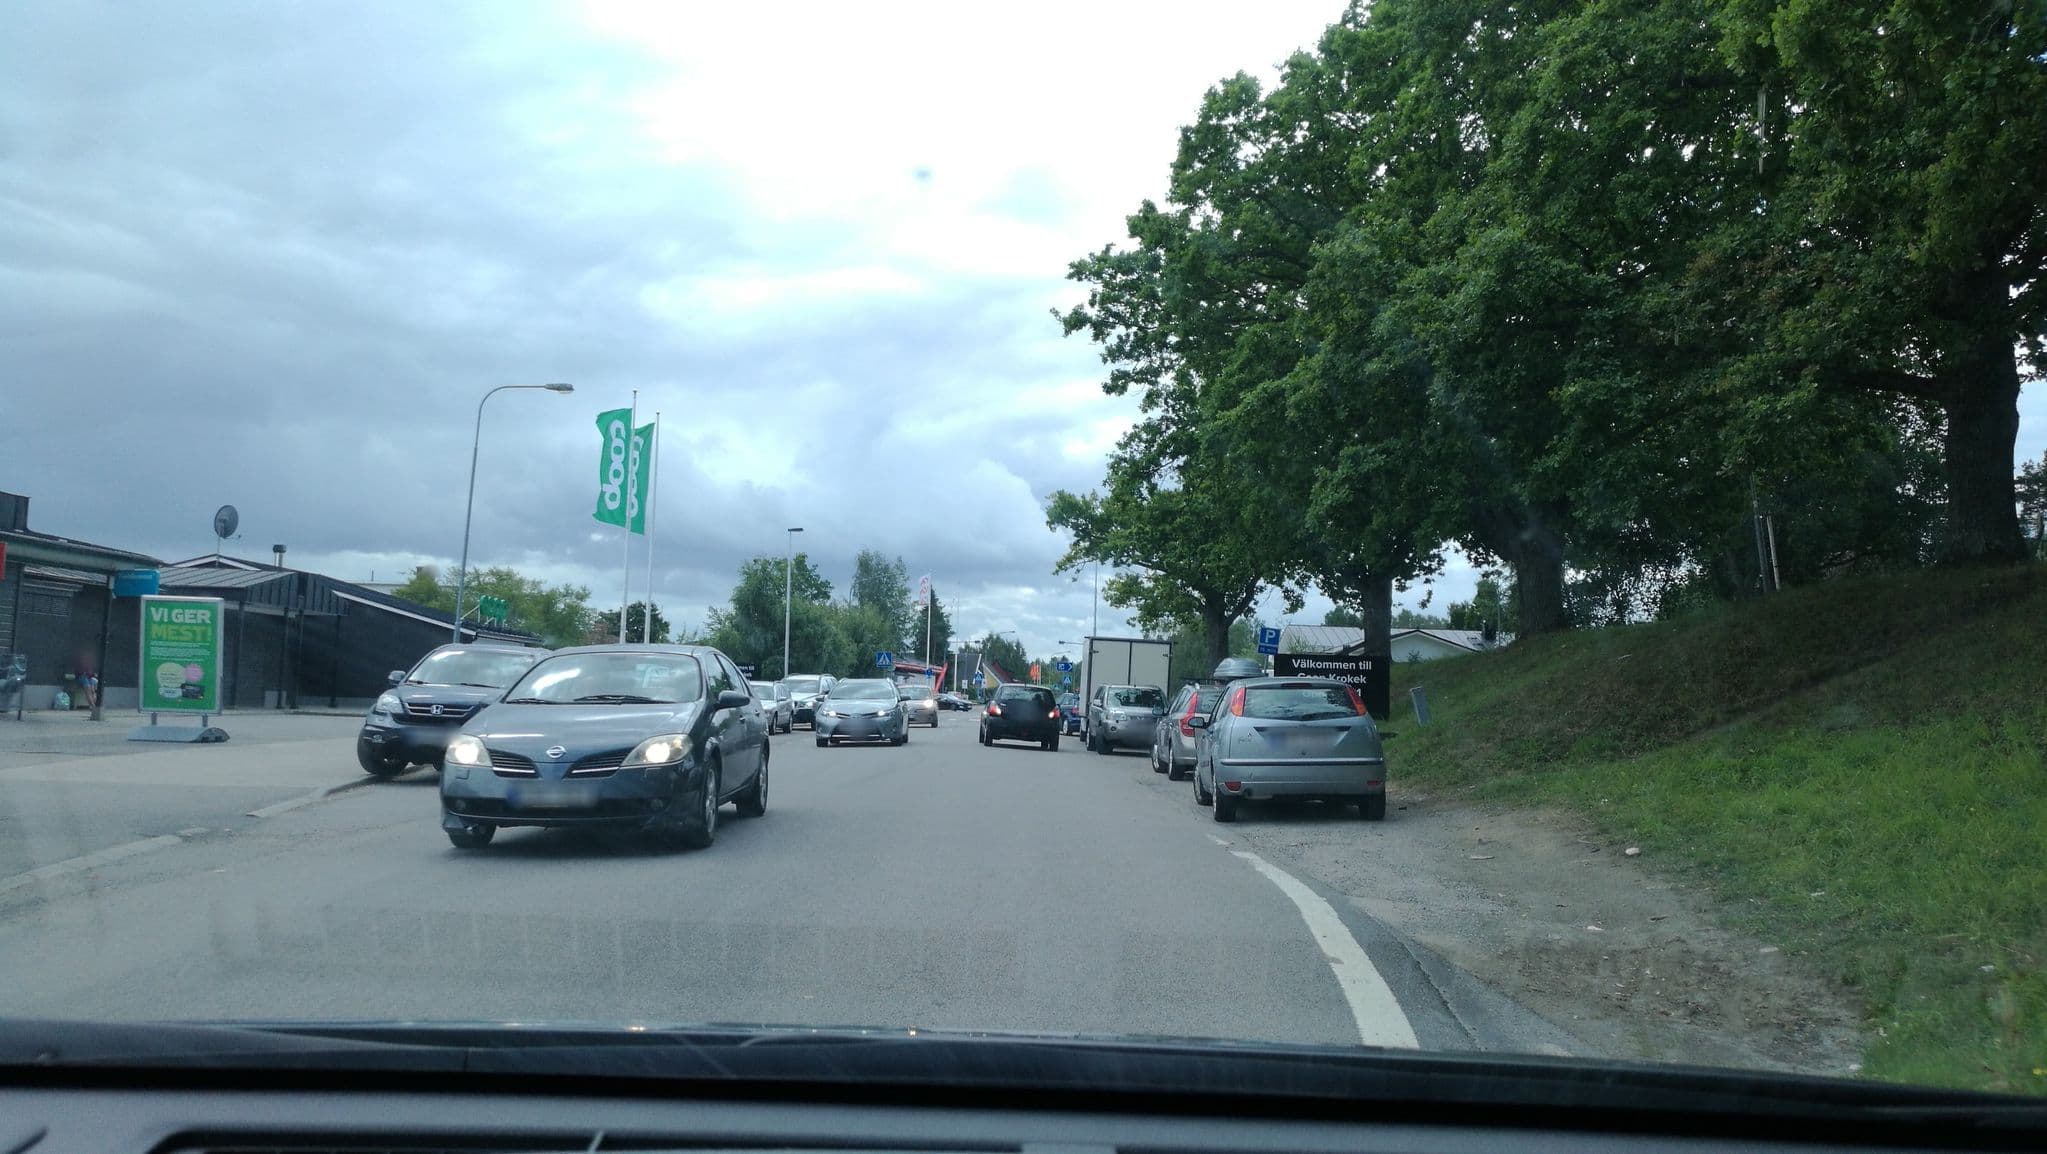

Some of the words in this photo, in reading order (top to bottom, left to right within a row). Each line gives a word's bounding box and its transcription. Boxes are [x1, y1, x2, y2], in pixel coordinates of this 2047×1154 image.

[150, 607, 168, 622] VI
[171, 608, 211, 623] GER
[151, 624, 212, 641] MEST!
[1265, 629, 1276, 643] P
[1292, 658, 1356, 670] Välkommen
[1359, 661, 1372, 670] till
[1328, 673, 1367, 684] Krokek
